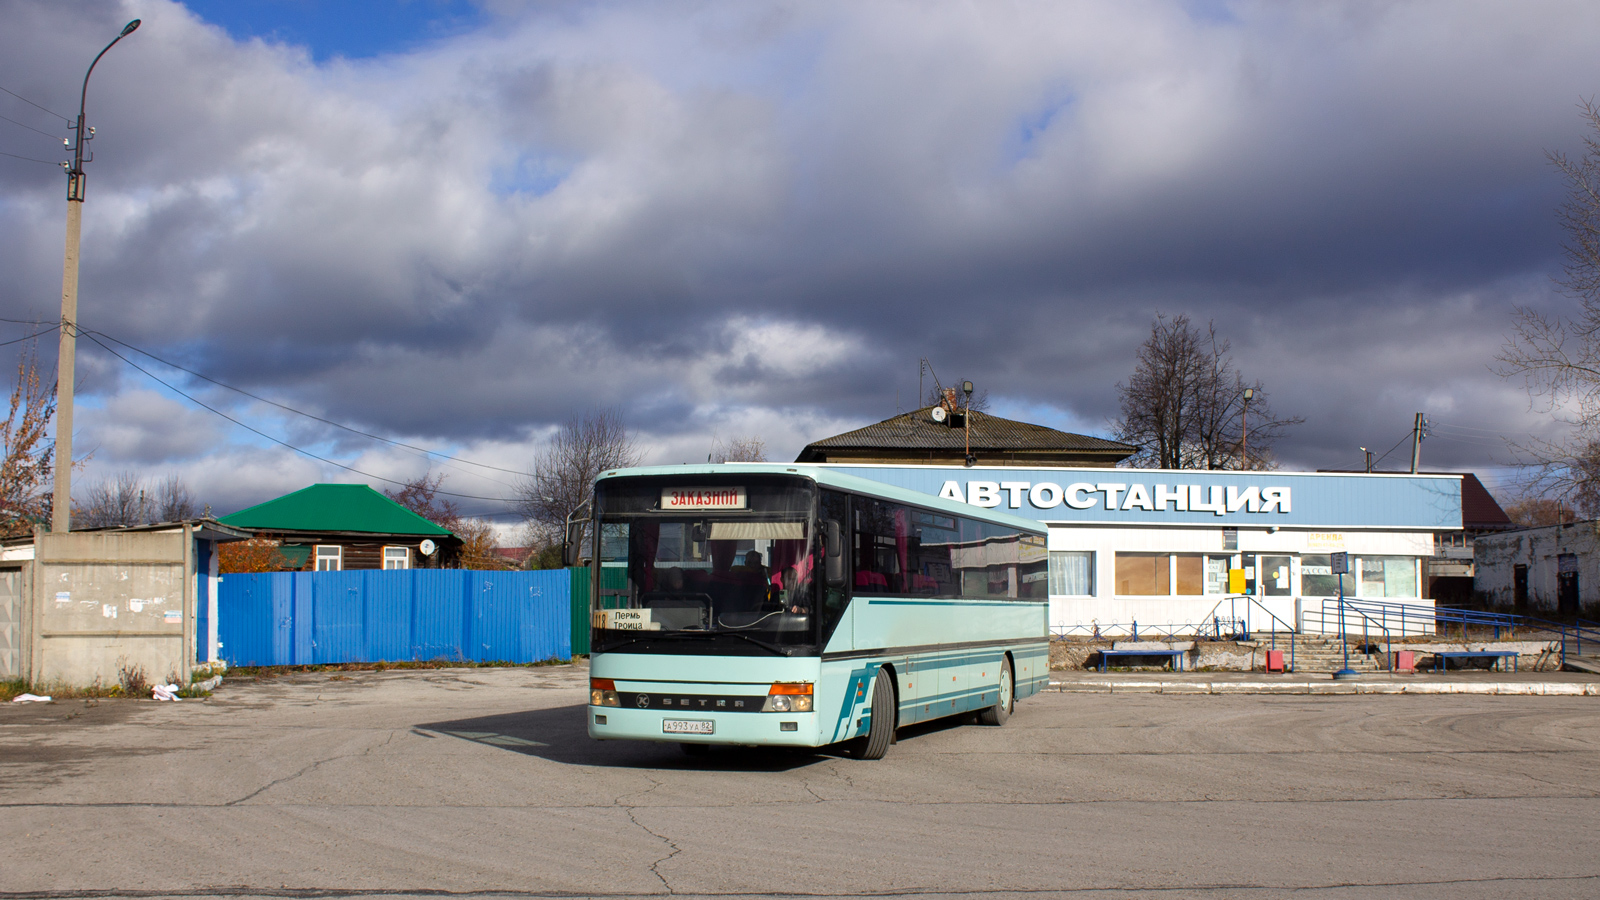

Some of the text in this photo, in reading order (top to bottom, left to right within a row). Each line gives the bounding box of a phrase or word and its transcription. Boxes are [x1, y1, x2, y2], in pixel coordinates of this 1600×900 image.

[671, 487, 738, 506] ЗАКАЗНОЙ
[939, 480, 1292, 516] АВТОСТАНЦИЯ
[1309, 533, 1343, 541] АРЕНДА
[615, 611, 641, 620] Пермь
[614, 621, 643, 630] Троица
[662, 697, 745, 708] SETRA
